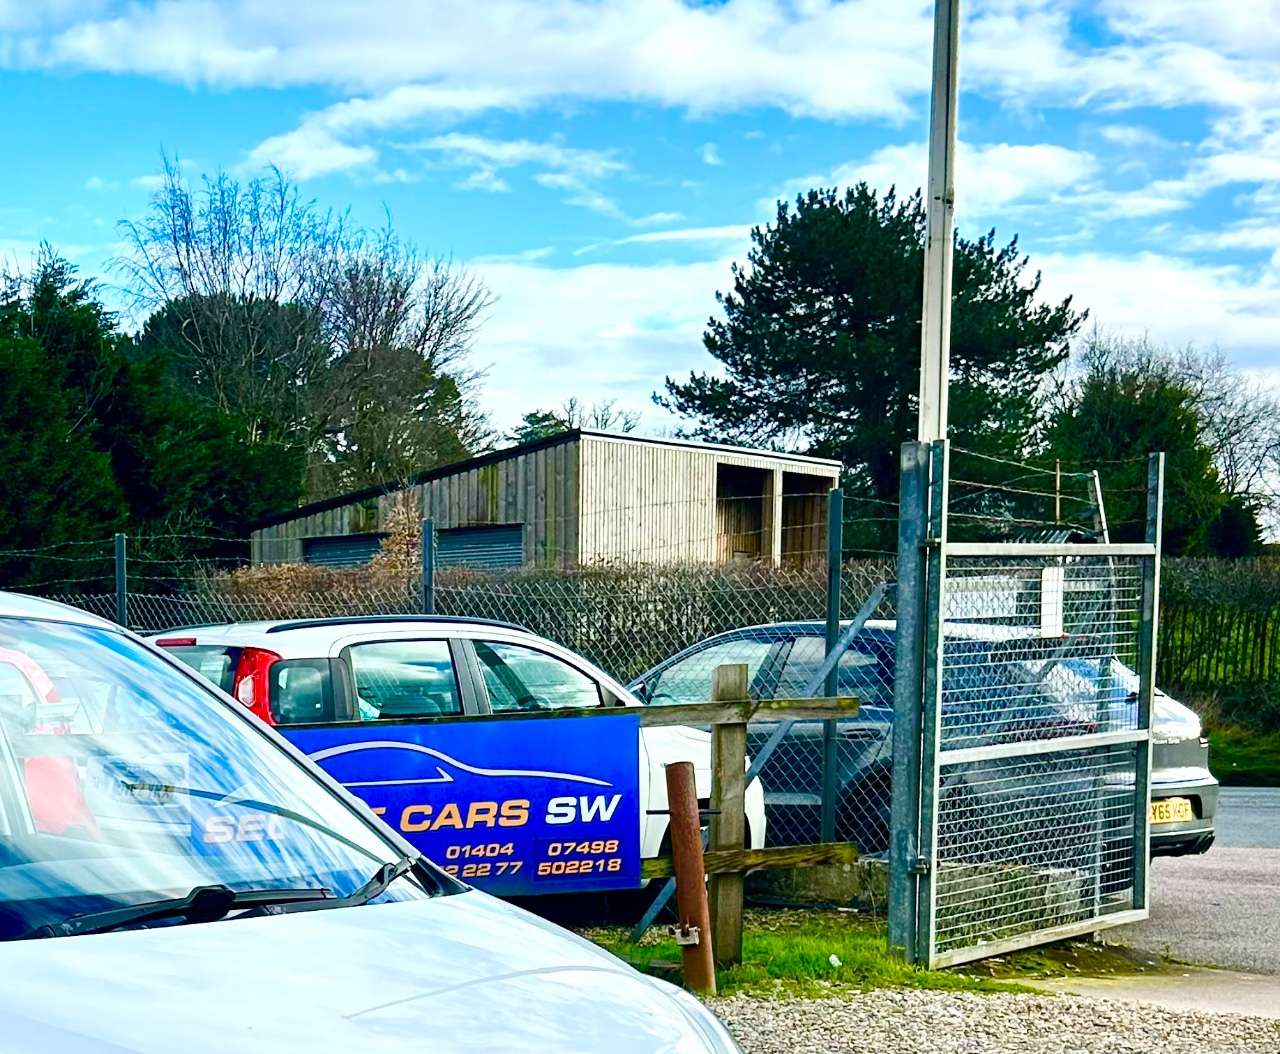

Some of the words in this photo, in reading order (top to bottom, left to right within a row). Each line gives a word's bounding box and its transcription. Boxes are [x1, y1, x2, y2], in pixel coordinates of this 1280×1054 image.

[400, 799, 530, 832] CARS
[545, 794, 622, 824] SW
[1151, 804, 1171, 820] Y65
[446, 843, 514, 859] 01404
[548, 840, 619, 857] 07498
[537, 859, 622, 875] 502218
